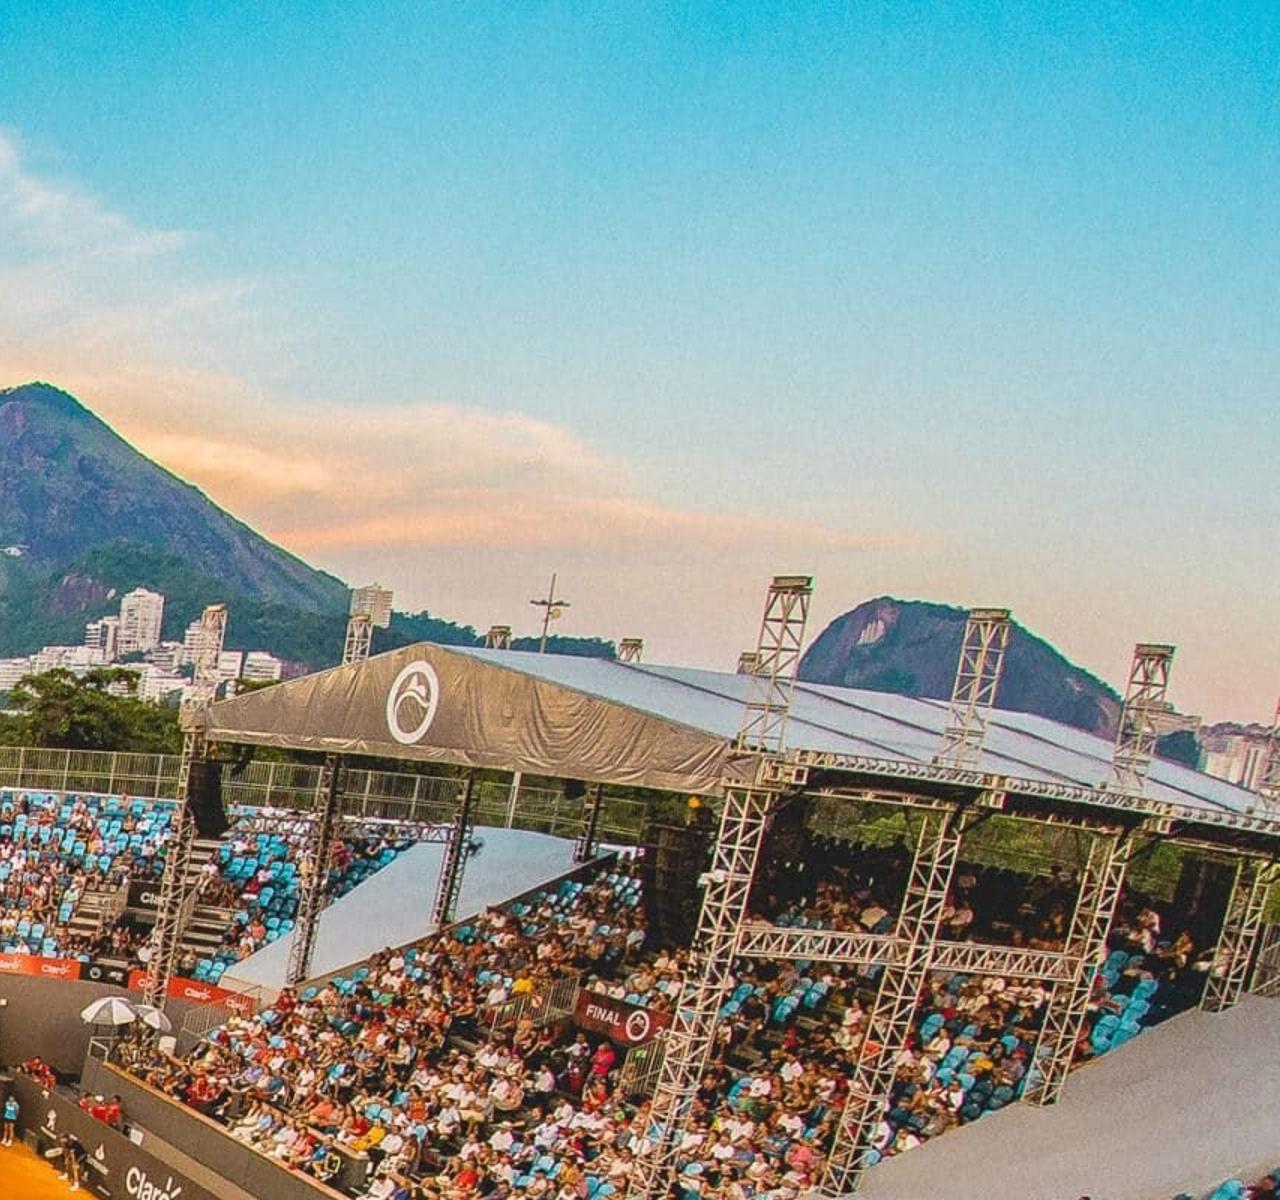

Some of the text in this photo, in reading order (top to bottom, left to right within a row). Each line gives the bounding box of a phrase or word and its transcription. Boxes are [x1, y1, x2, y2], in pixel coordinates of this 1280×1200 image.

[41, 963, 71, 977] Claro
[184, 986, 210, 1000] Claro
[585, 1004, 621, 1026] FINAL
